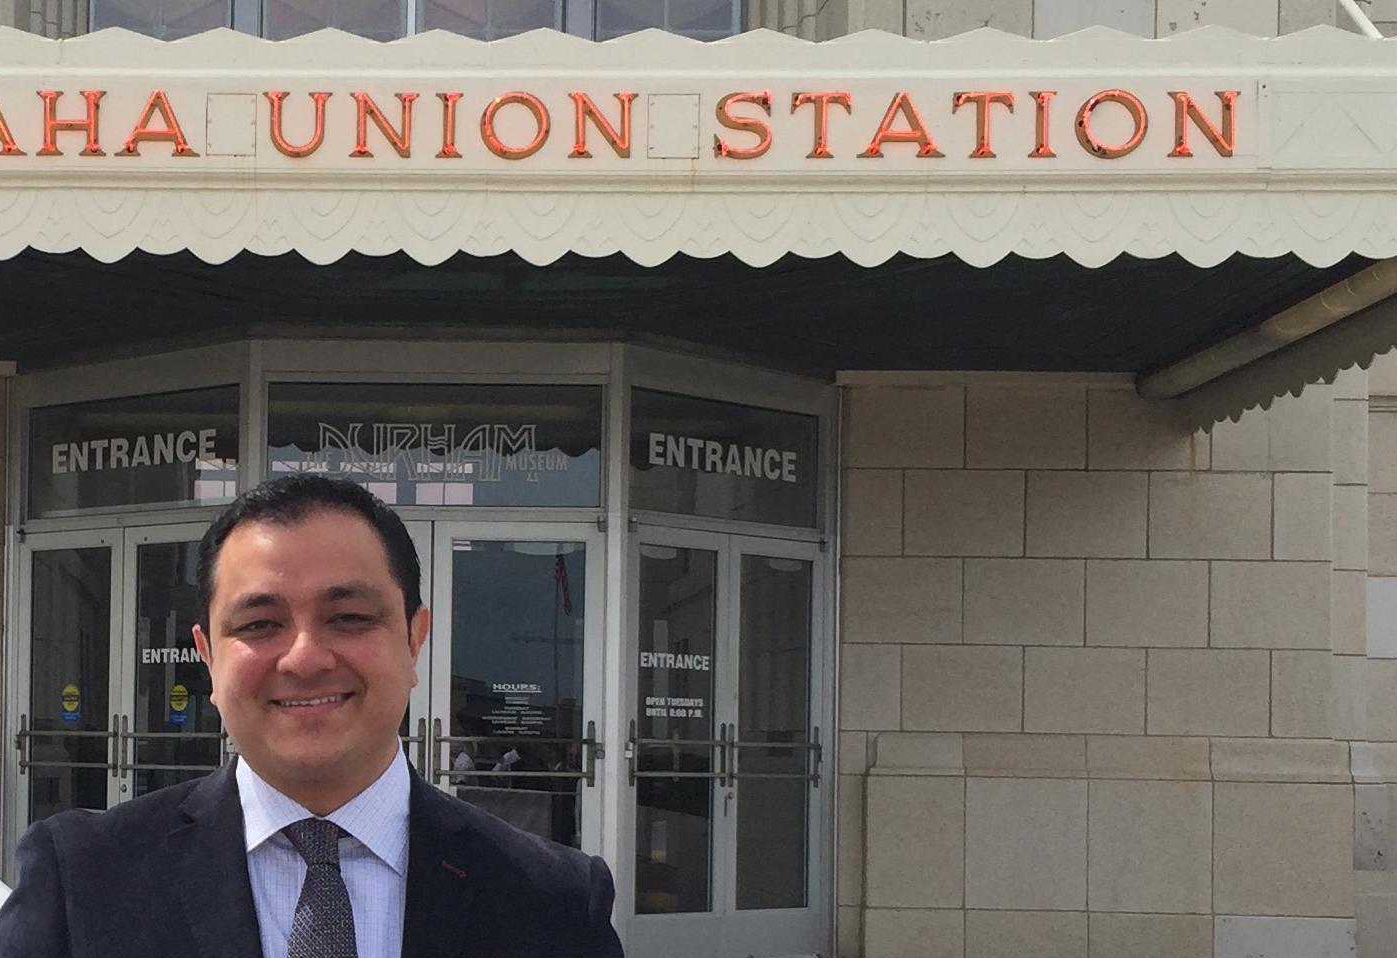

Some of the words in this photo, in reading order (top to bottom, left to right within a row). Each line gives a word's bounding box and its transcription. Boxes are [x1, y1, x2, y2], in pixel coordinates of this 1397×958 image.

[263, 91, 638, 160] UNION
[714, 89, 1241, 159] STATION
[52, 428, 217, 474] ENTRANCE
[318, 423, 538, 481] DURHAM
[506, 453, 570, 472] MUSEUM
[649, 432, 797, 482] ENTRANCE
[142, 648, 205, 664] ENTRAN
[640, 652, 710, 670] ENTRANCE
